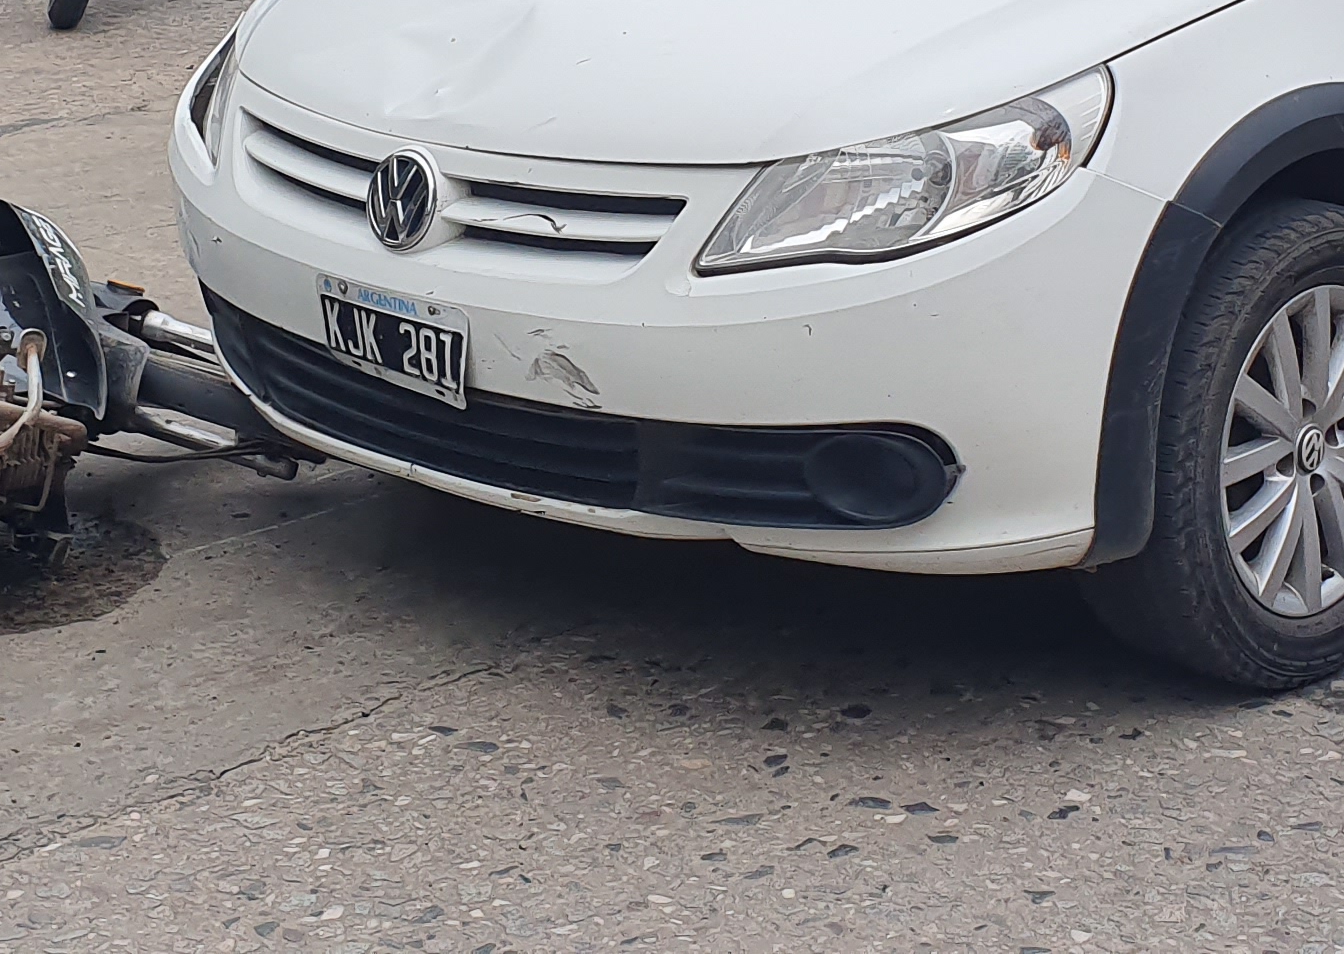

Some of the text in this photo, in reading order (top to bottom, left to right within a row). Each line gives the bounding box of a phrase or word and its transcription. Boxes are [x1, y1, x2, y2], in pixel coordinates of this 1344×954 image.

[357, 288, 419, 316] ARGENTINA
[324, 298, 458, 390] KJK 281
